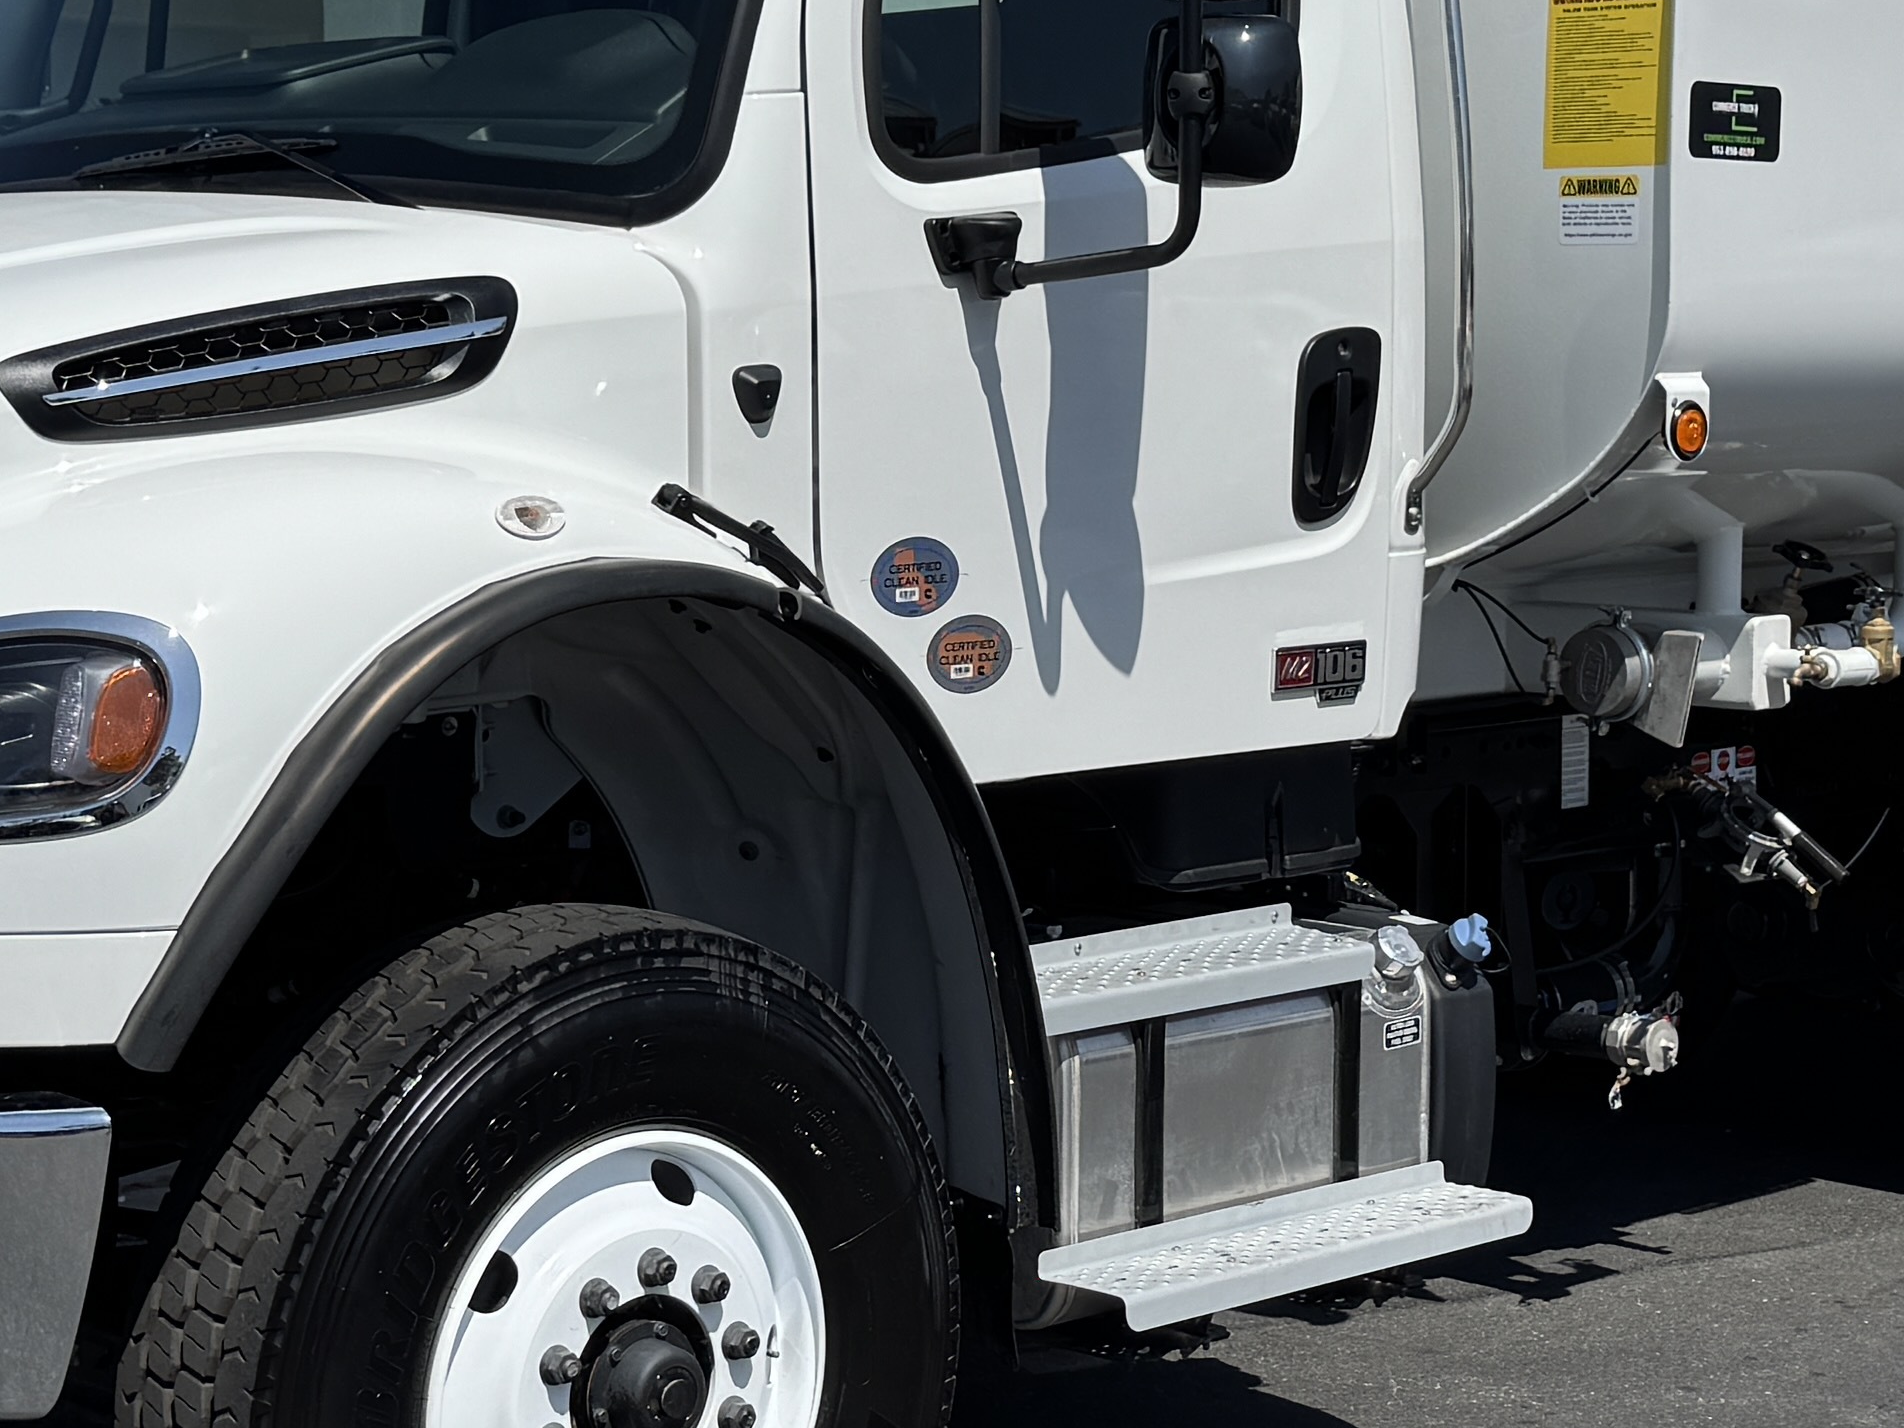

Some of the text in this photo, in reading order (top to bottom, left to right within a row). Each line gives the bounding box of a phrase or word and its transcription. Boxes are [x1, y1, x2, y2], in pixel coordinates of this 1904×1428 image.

[1576, 178, 1620, 196] WARNING
[889, 561, 942, 574] CERTIFIED
[884, 573, 947, 588] CLEAN IDLE
[944, 639, 995, 652] CERTIFIED
[939, 651, 1000, 666] CLEAN IDLE
[1279, 647, 1364, 684] M2 106
[1320, 687, 1357, 700] PLUS
